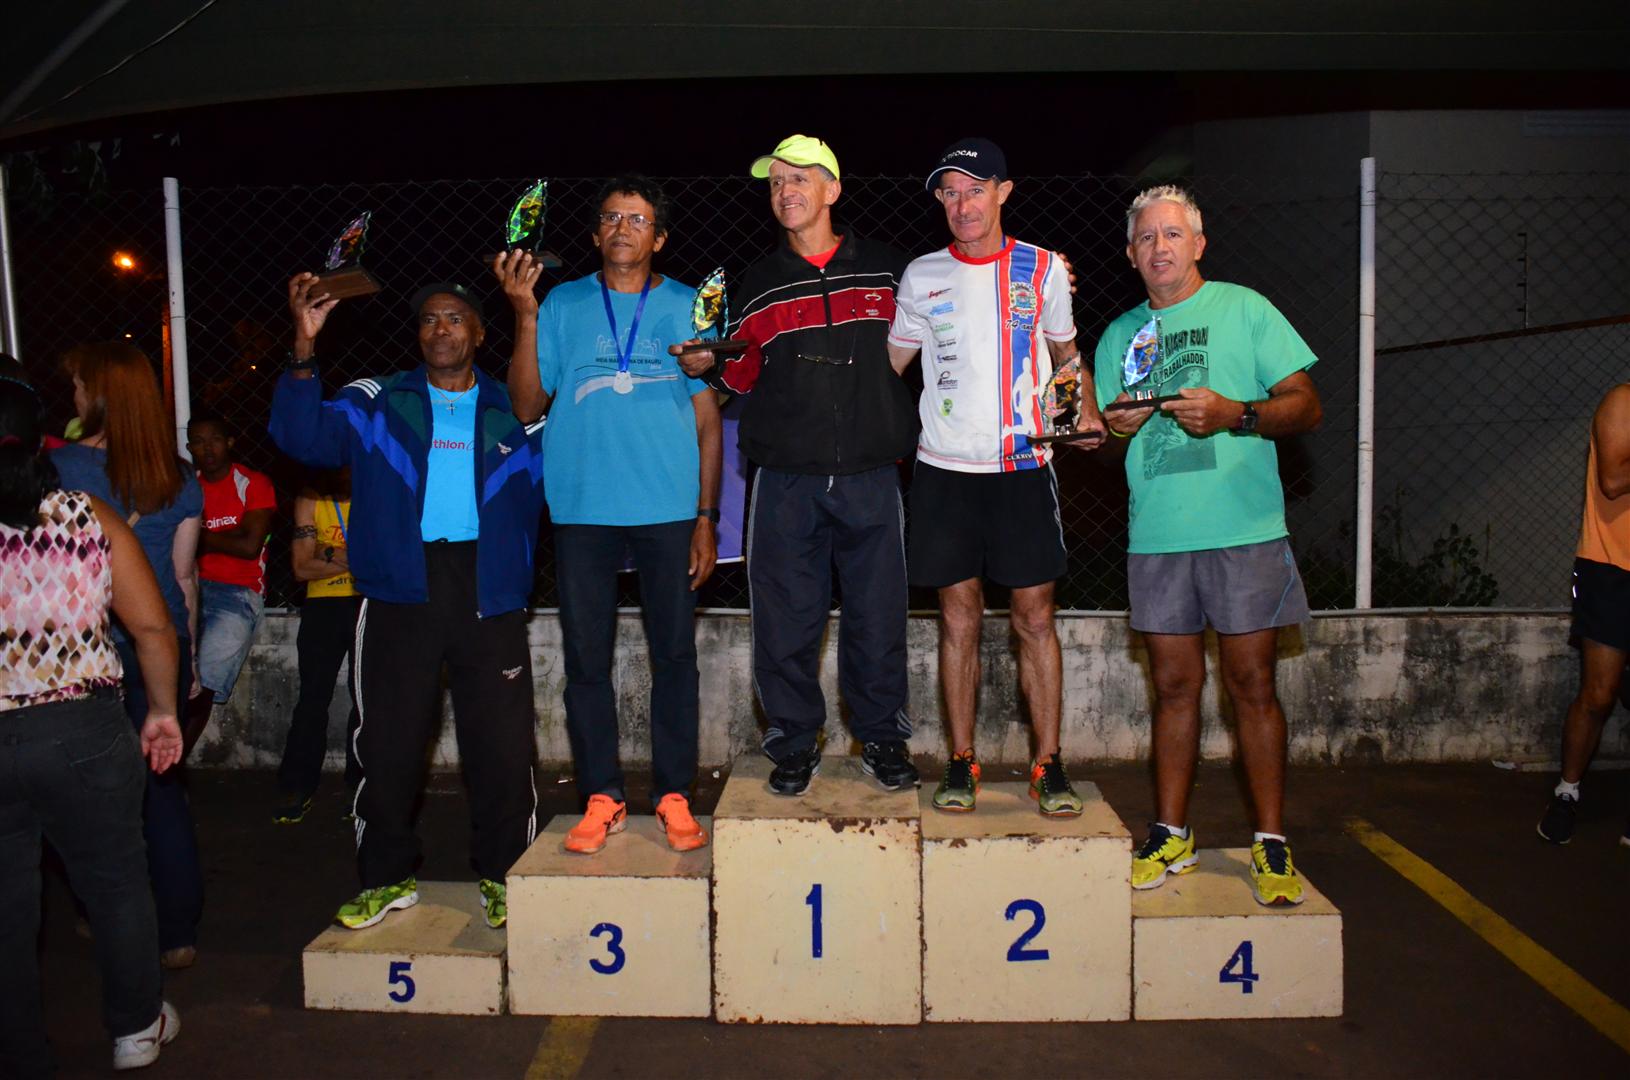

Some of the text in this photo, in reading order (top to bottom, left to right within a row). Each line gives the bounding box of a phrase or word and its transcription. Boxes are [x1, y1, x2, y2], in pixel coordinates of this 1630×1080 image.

[1190, 326, 1208, 346] RUN
[805, 883, 822, 958] 1
[1004, 898, 1050, 962] 2
[589, 922, 626, 975] 3
[1219, 940, 1259, 993] 4
[388, 961, 416, 1003] 5
